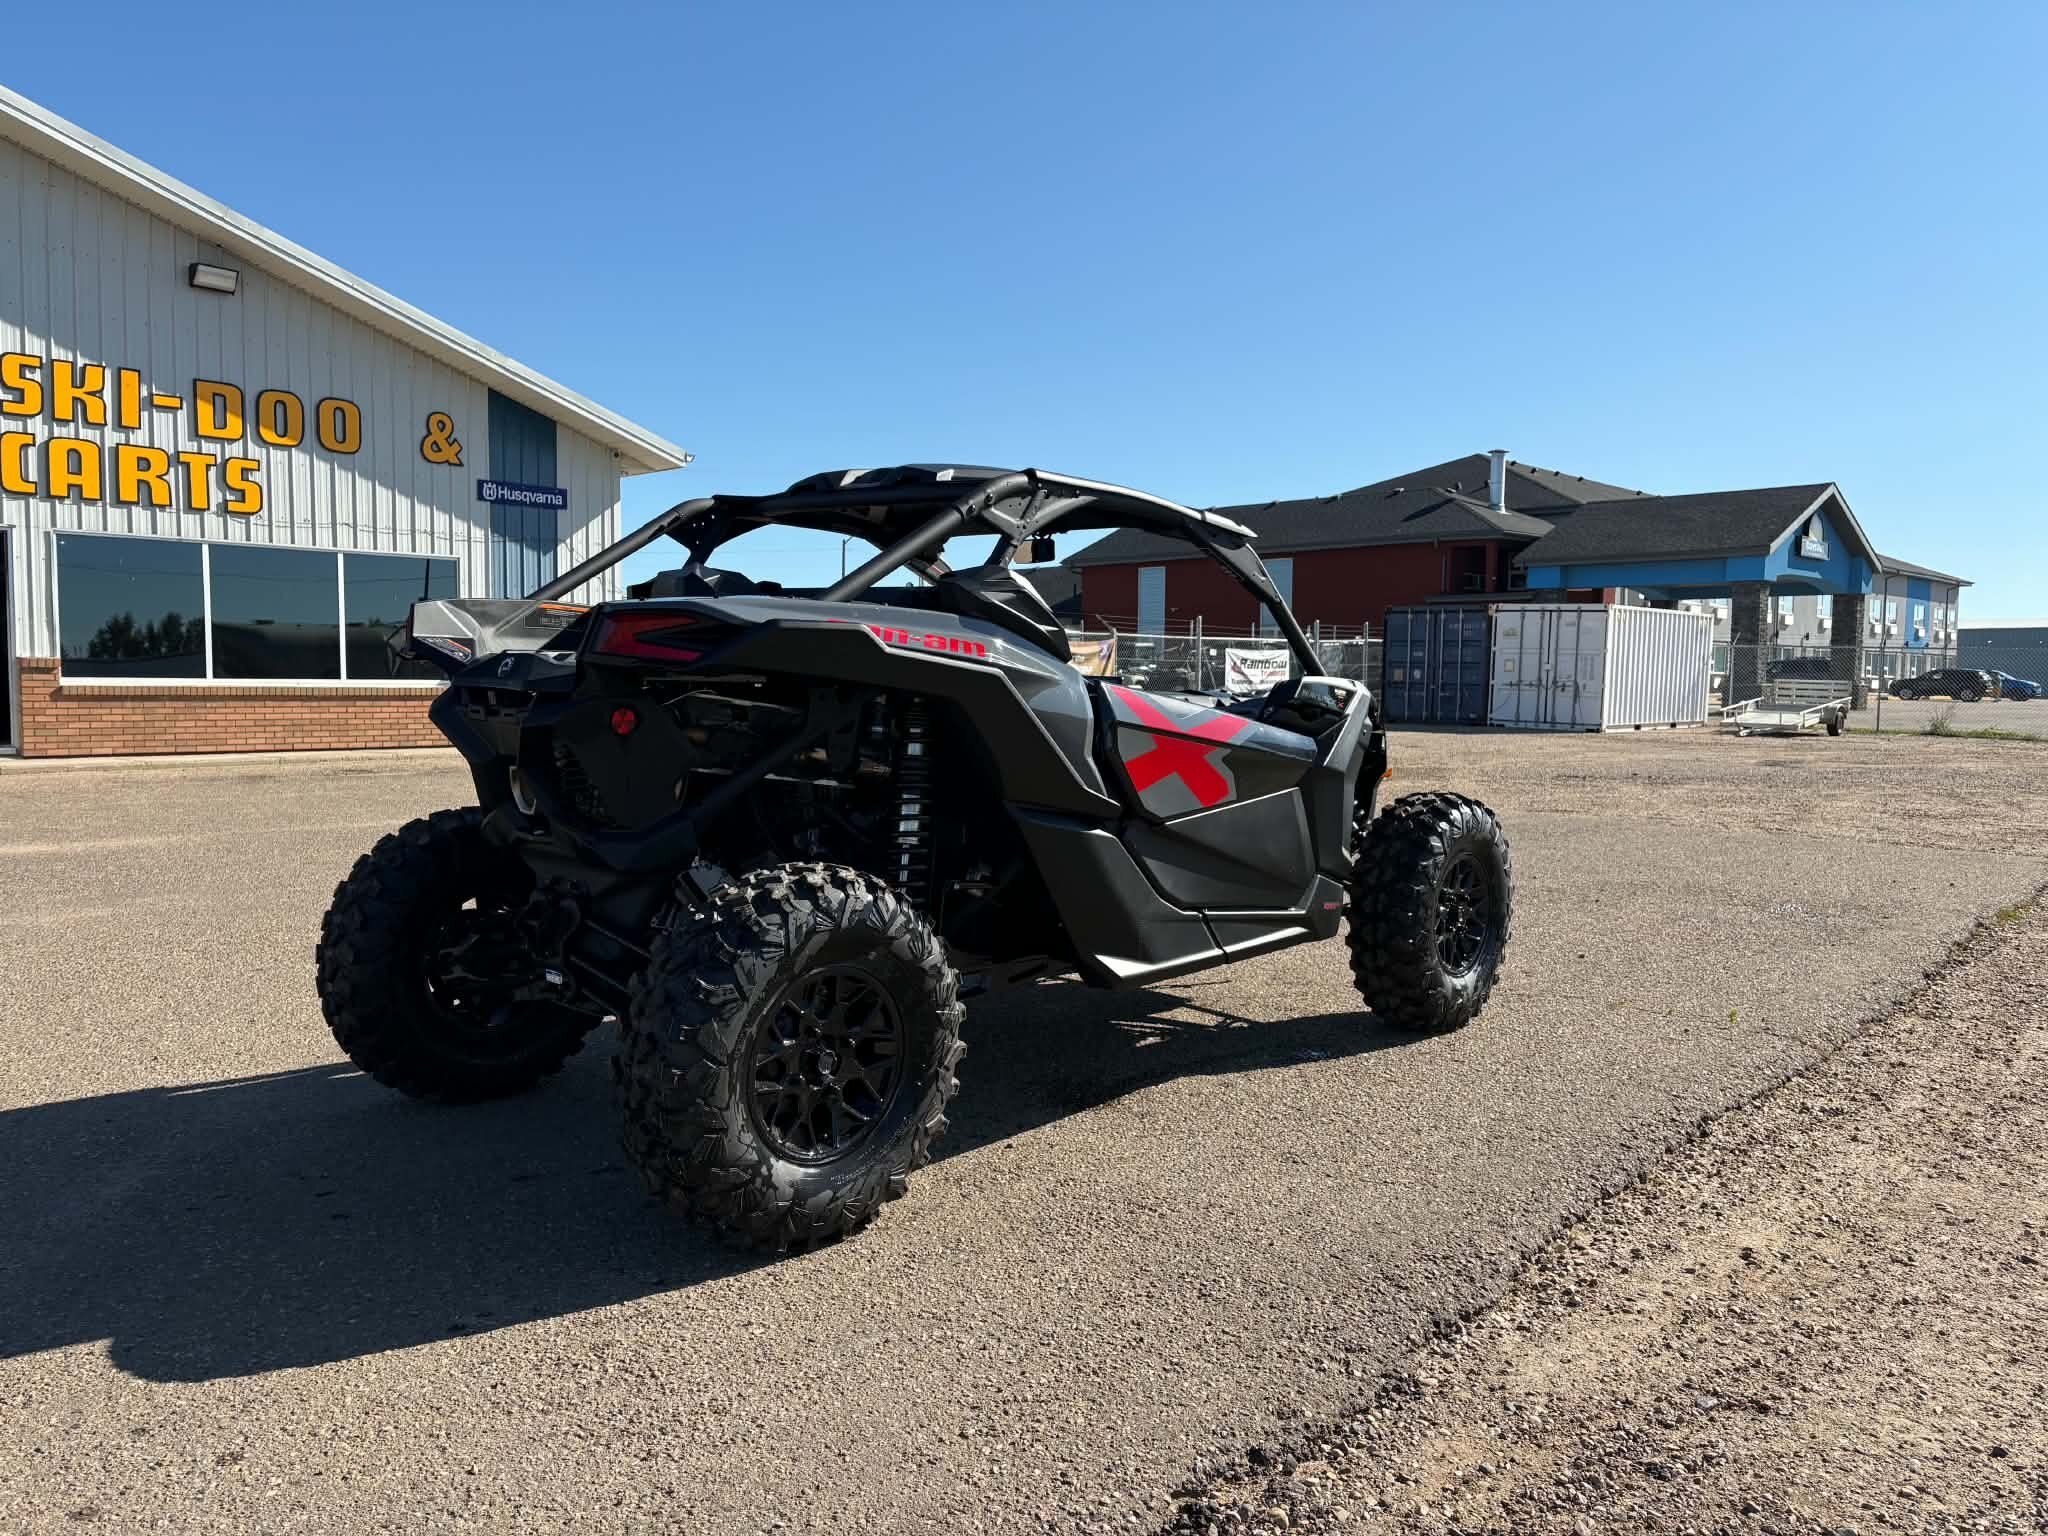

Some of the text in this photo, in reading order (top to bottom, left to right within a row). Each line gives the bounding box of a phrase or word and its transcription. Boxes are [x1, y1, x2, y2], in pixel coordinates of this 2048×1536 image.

[0, 352, 464, 467] SKI-DOO &
[0, 431, 263, 516] CARTS
[497, 485, 563, 505] Husqvarna
[1240, 658, 1288, 670] Rainbow
